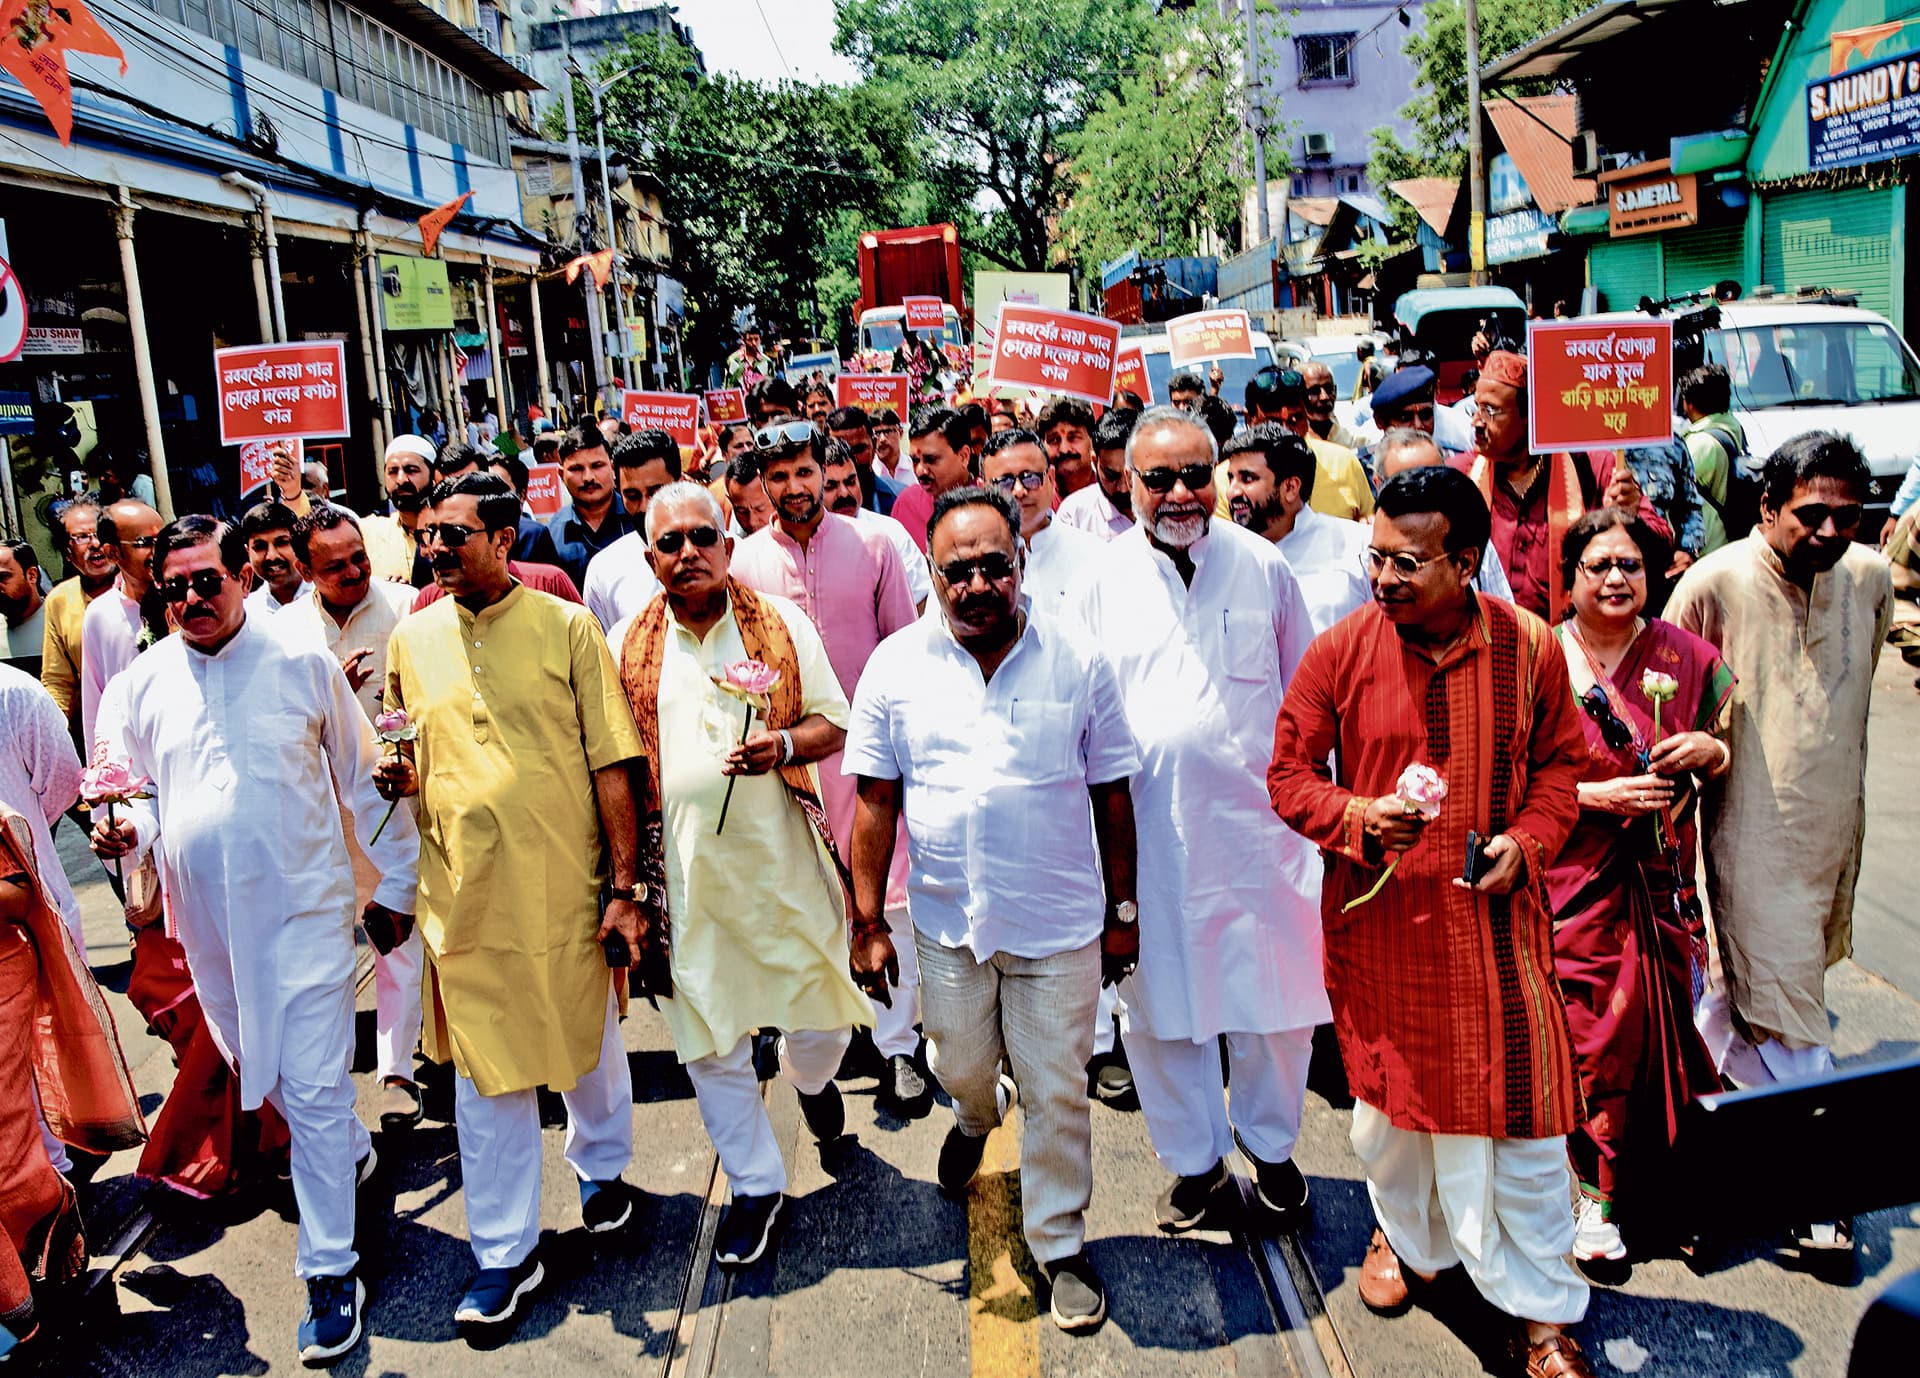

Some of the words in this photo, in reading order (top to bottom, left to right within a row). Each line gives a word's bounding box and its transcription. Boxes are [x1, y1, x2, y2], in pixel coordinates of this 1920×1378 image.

[1810, 61, 1906, 121] S.NUNDY
[1862, 115, 1889, 133] ORDER
[26, 329, 47, 338] AJU
[50, 329, 79, 339] SHAW
[1006, 319, 1059, 343] নববর্ষের
[1060, 327, 1087, 347] নয়া
[1088, 334, 1112, 352] গান
[1565, 331, 1616, 361] নববর্ষে
[1615, 336, 1656, 361] যোগ্যরা
[1001, 338, 1043, 359] চোরের
[1044, 344, 1080, 366] দলের
[1081, 351, 1110, 372] কাটা
[224, 359, 273, 387] নববর্ষের
[275, 363, 302, 381] নয়া
[304, 361, 334, 378] গান
[1040, 363, 1070, 382] কান
[1582, 363, 1612, 382] যাক
[1613, 362, 1646, 388] স্কুলে
[225, 388, 260, 412] চোরের
[262, 385, 301, 407] দলের
[302, 380, 337, 400] কাটা
[1561, 382, 1592, 411] বাড়ি
[1594, 388, 1624, 409] ছাড়া
[1626, 381, 1659, 410] হিন্দুরা
[262, 408, 292, 424] কান
[1603, 412, 1628, 434] ঘরে
